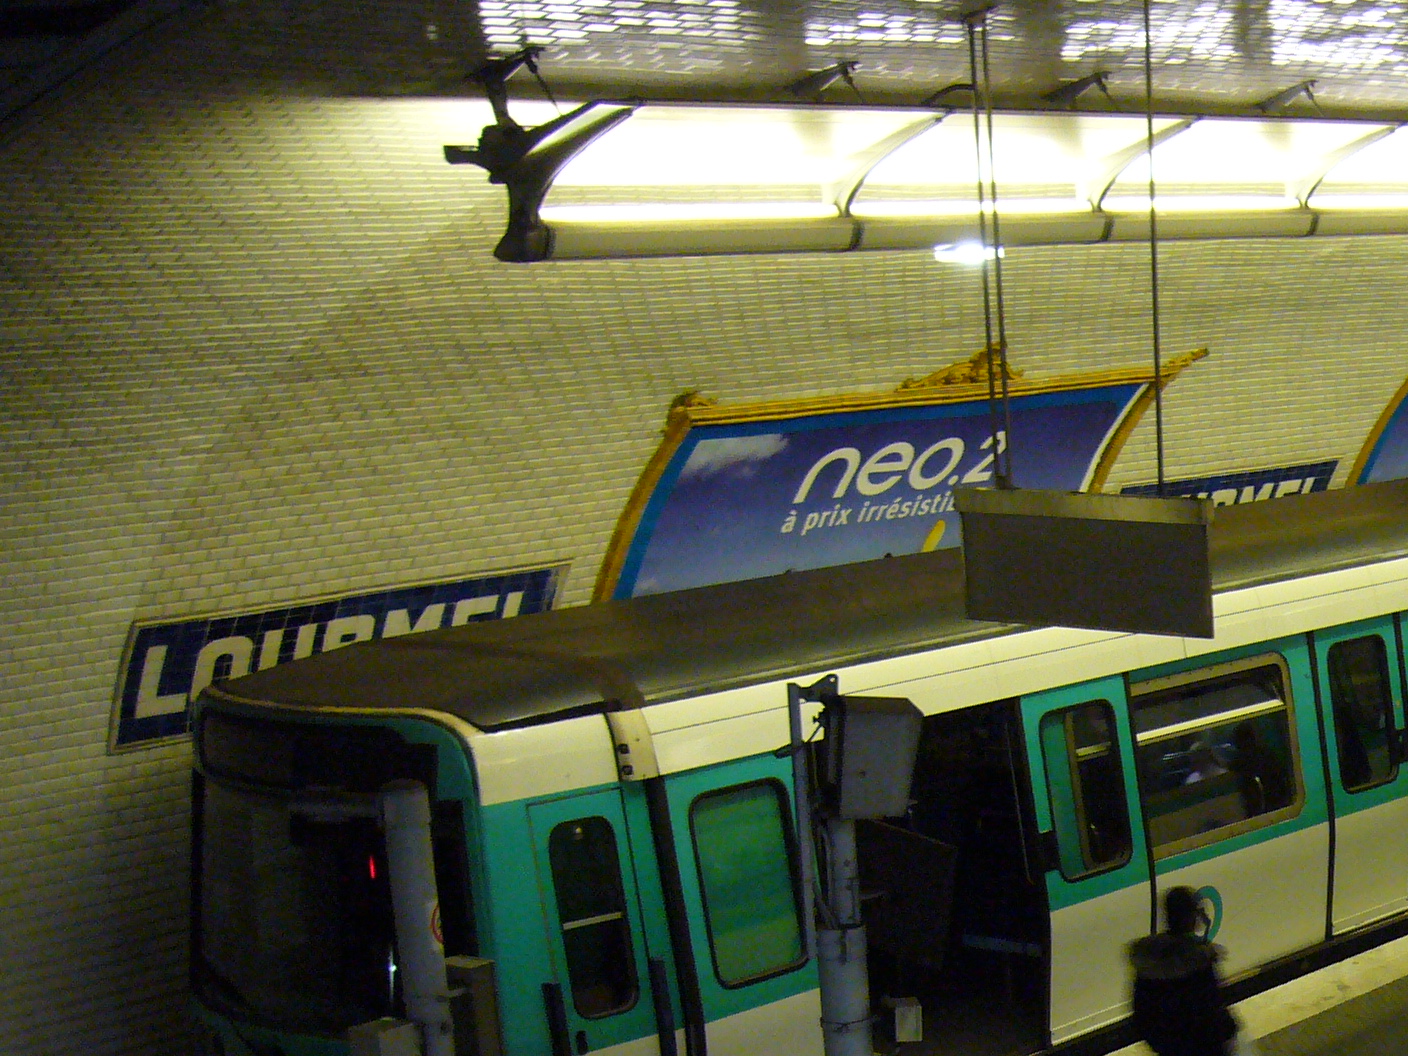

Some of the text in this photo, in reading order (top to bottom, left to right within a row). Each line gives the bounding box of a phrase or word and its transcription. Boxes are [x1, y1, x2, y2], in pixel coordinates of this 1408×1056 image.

[792, 431, 1007, 504] neo.2
[781, 491, 956, 536] à prix irrésisti
